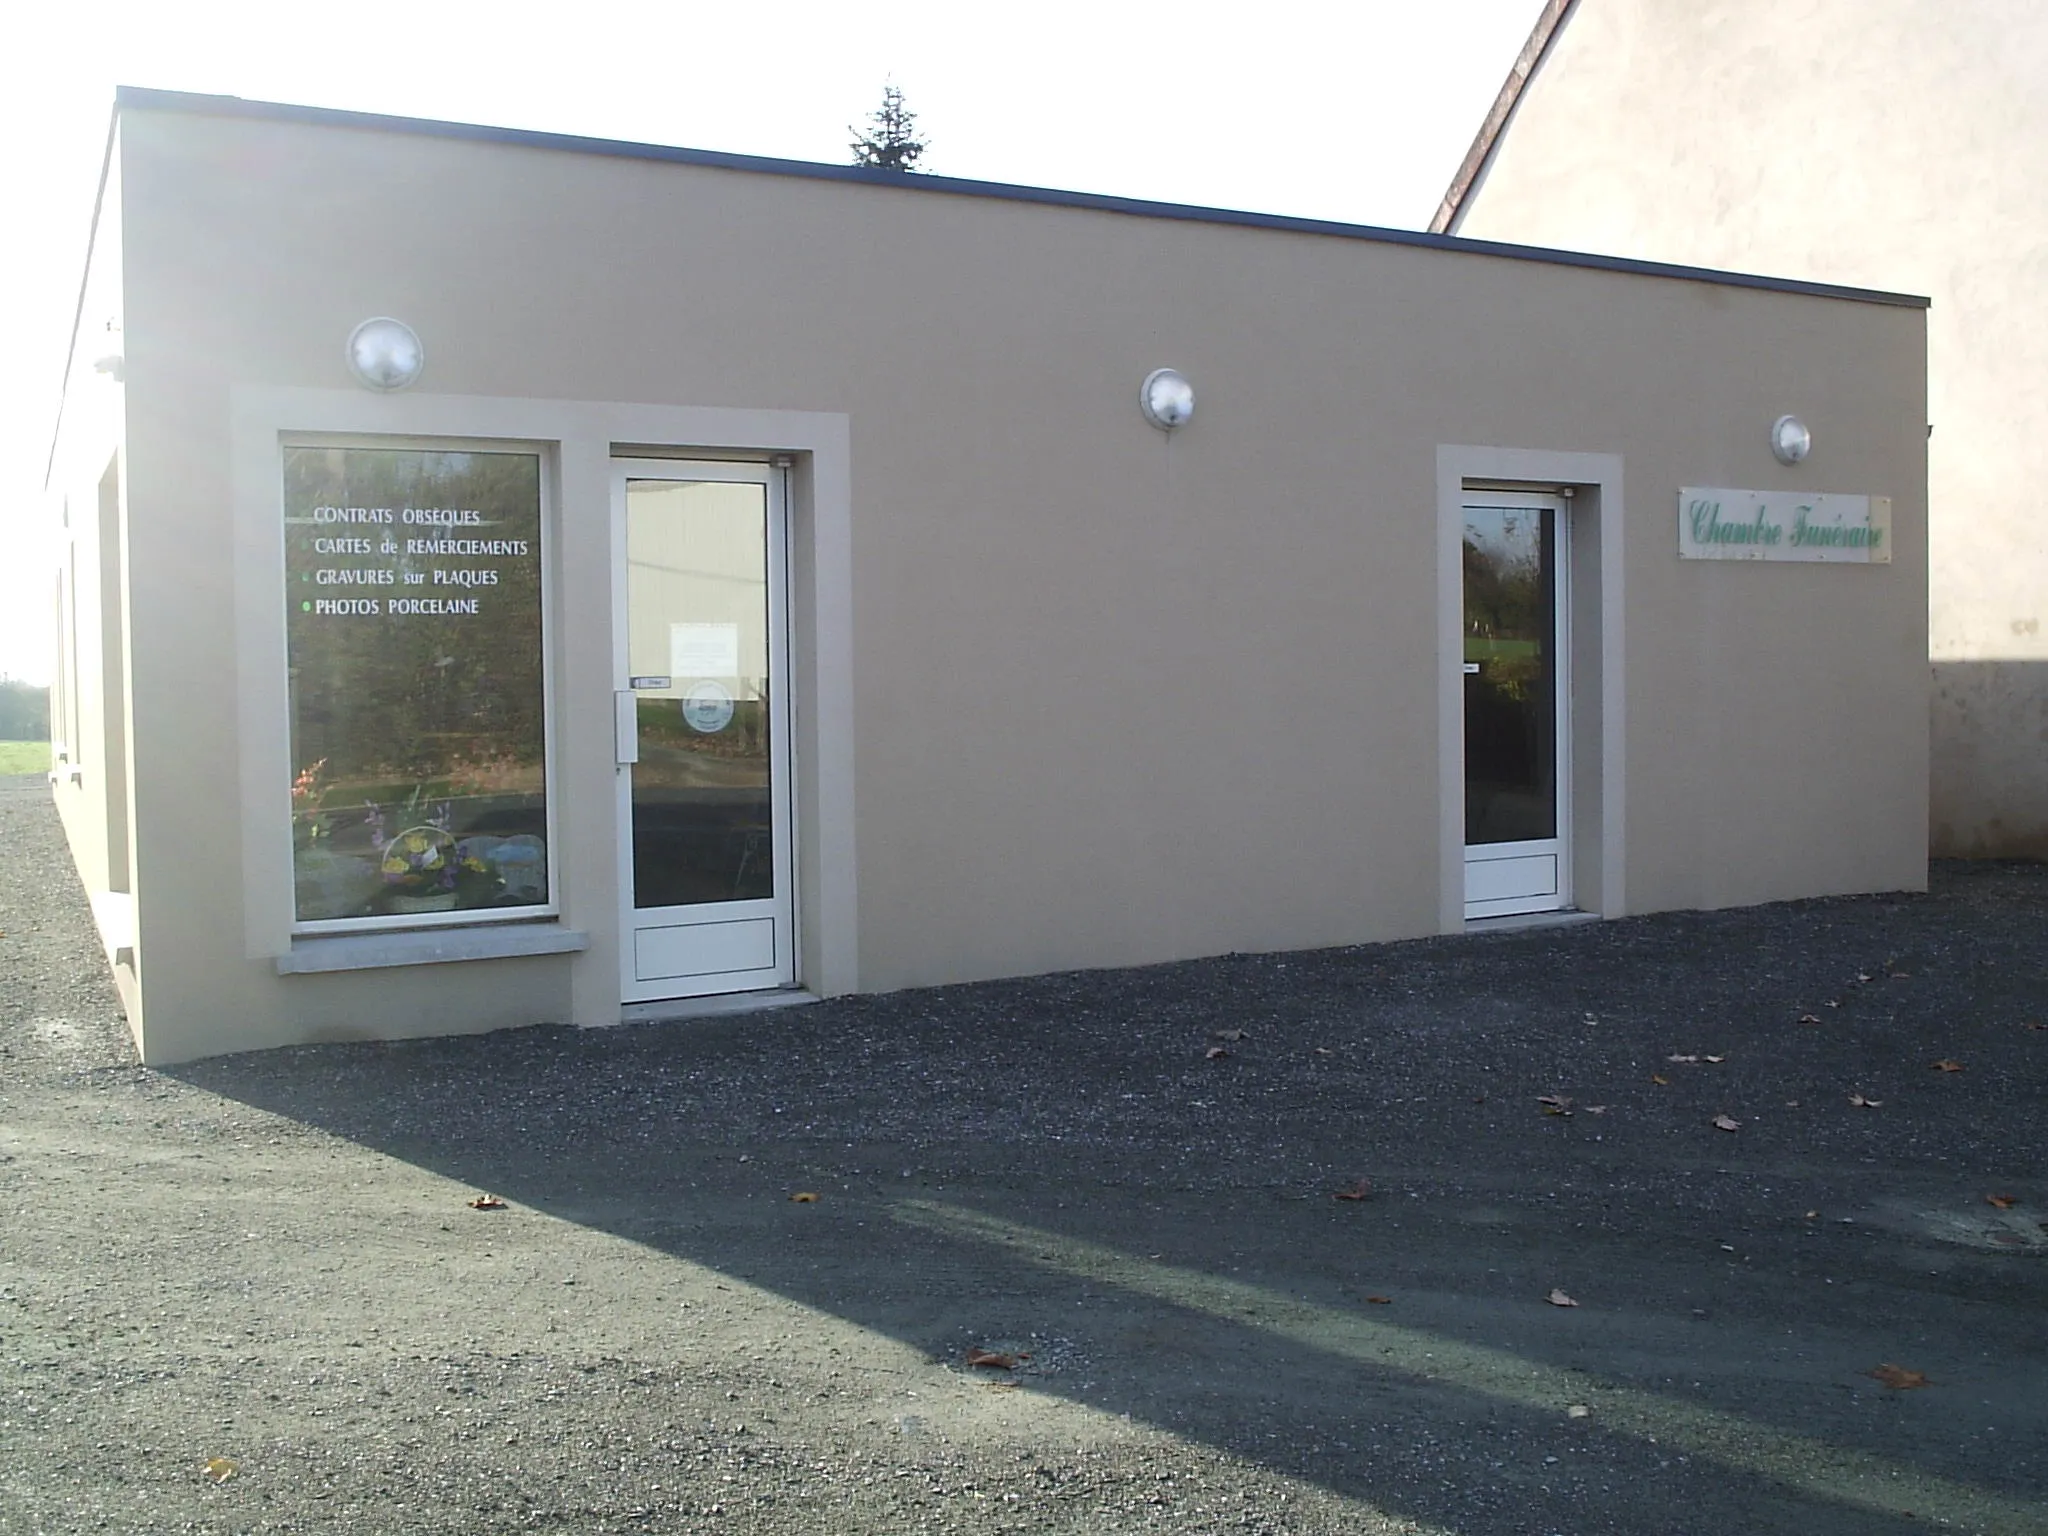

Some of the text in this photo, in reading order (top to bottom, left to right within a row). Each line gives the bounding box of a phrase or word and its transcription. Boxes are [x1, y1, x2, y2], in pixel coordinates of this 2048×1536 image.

[314, 507, 393, 524] CONTRATS
[1689, 500, 1783, 545] Chambre
[315, 538, 528, 556] CARTES de REMERCIEMENTS
[316, 569, 498, 589] GRAVURES sur PLAQUES
[315, 599, 480, 615] PHOTOS PORCELAINE
